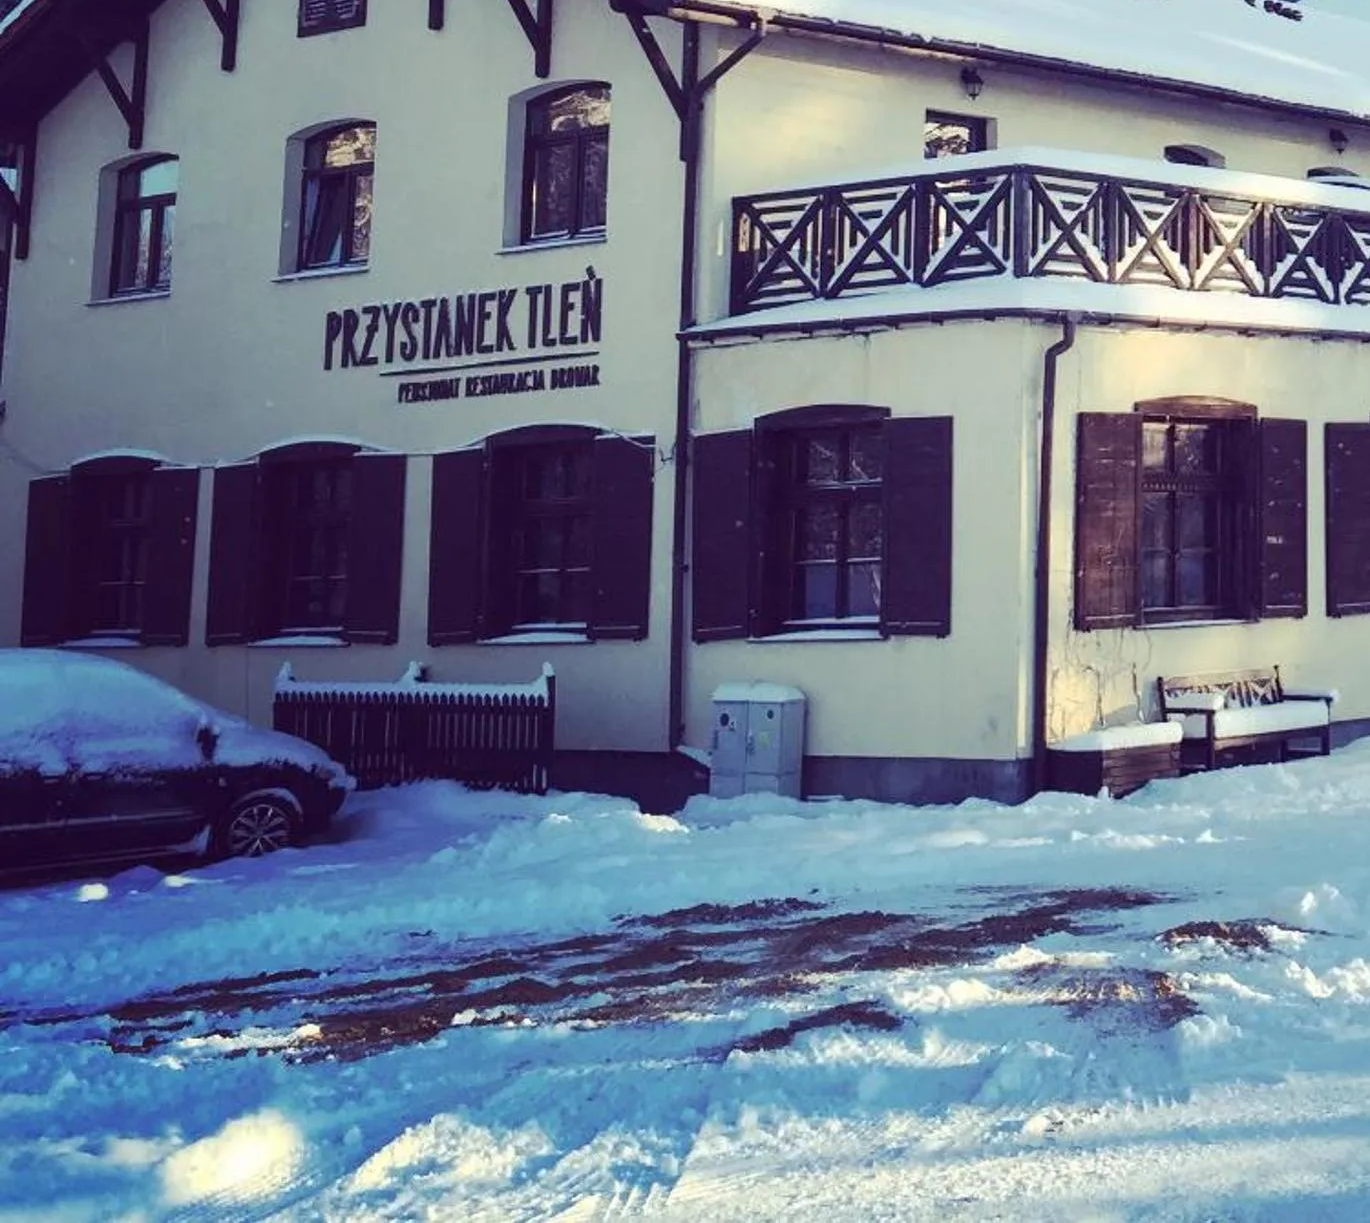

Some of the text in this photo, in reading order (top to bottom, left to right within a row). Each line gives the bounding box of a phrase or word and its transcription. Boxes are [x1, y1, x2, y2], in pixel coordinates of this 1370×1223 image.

[323, 265, 603, 371] PRZYSTANEK TLEŃ
[465, 369, 545, 397] RESTAURACJA
